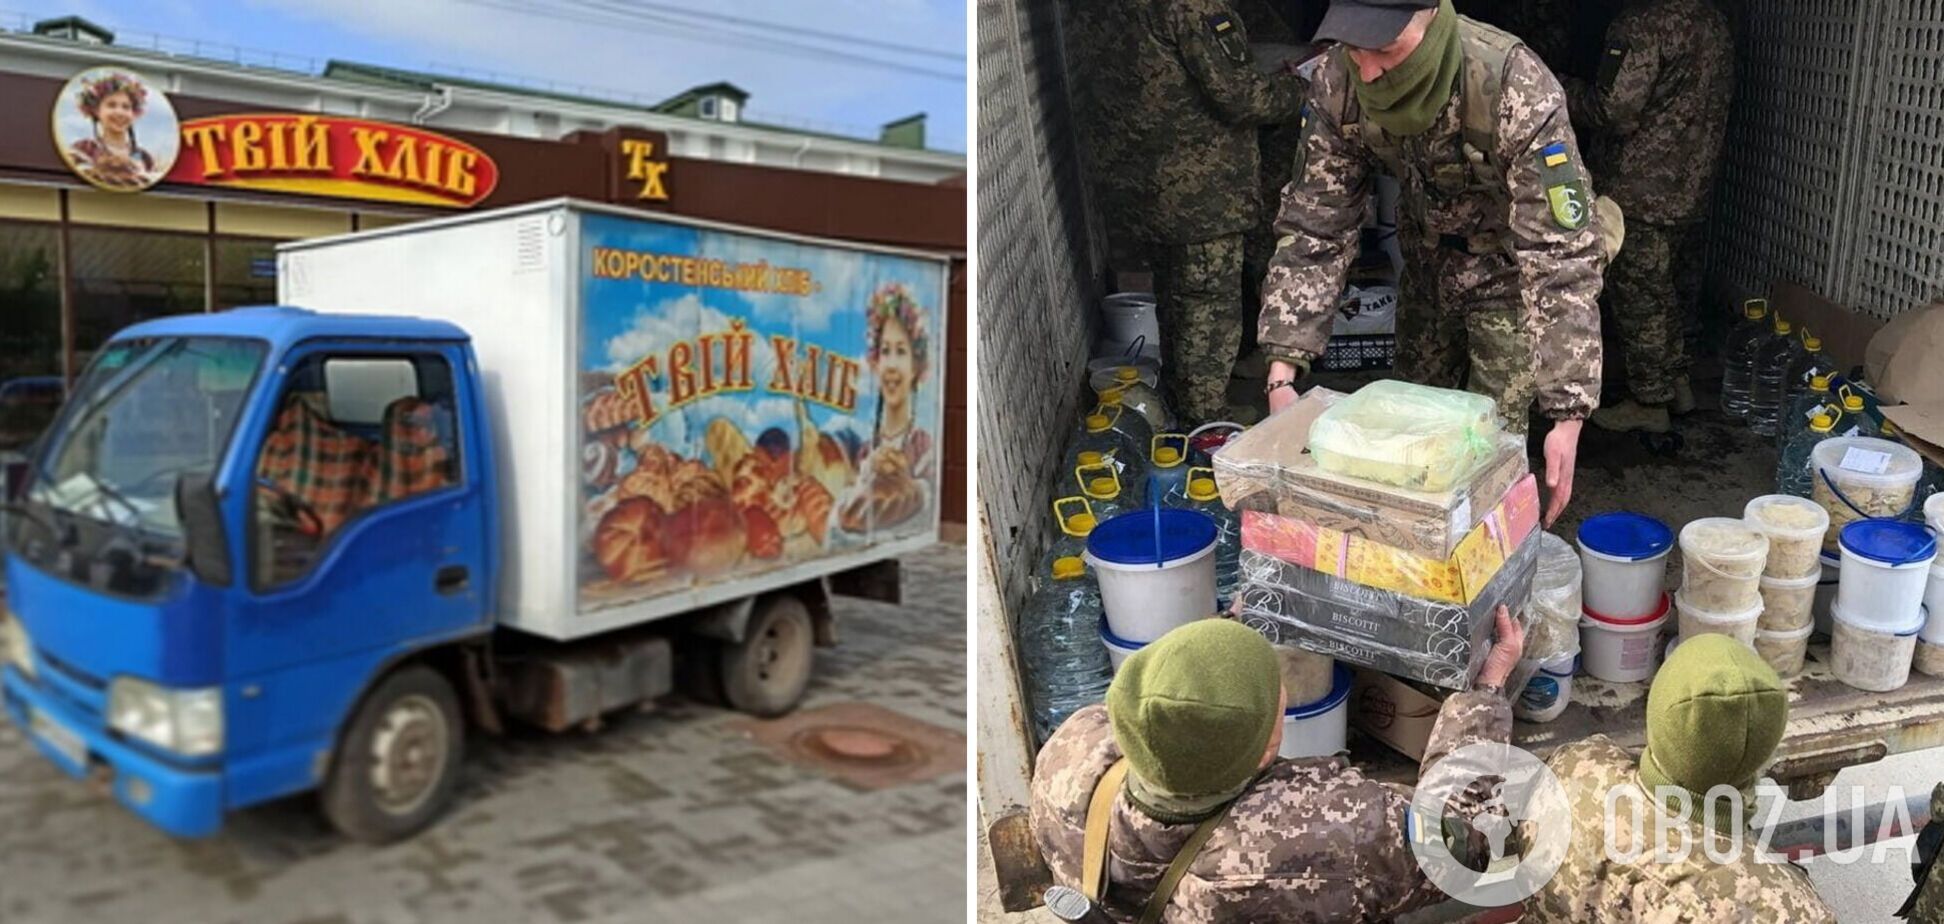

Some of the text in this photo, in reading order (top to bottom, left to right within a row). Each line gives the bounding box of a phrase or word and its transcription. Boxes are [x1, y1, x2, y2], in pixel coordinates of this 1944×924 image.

[183, 117, 479, 196] ТВІЙ ХЛІБ
[616, 315, 860, 429] ТВІЙ ХЛІБ
[1331, 611, 1379, 632] BISCOTTI
[1328, 640, 1375, 659] BISCOTTI
